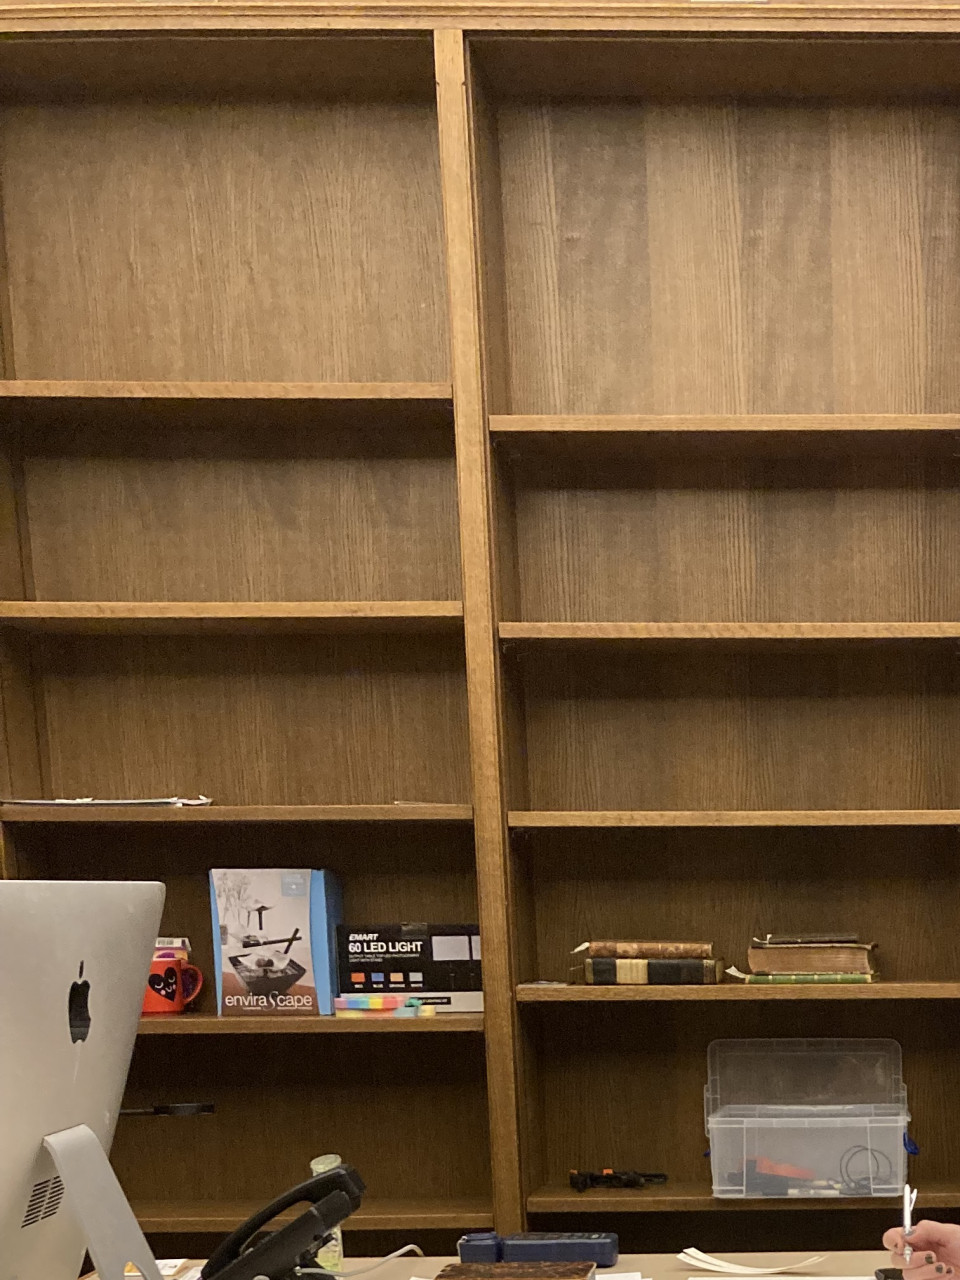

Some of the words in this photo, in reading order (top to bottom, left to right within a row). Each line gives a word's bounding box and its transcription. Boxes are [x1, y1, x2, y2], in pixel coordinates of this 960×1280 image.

[348, 942, 362, 953] 60
[364, 942, 387, 953] LED
[388, 941, 423, 952] LIGHT
